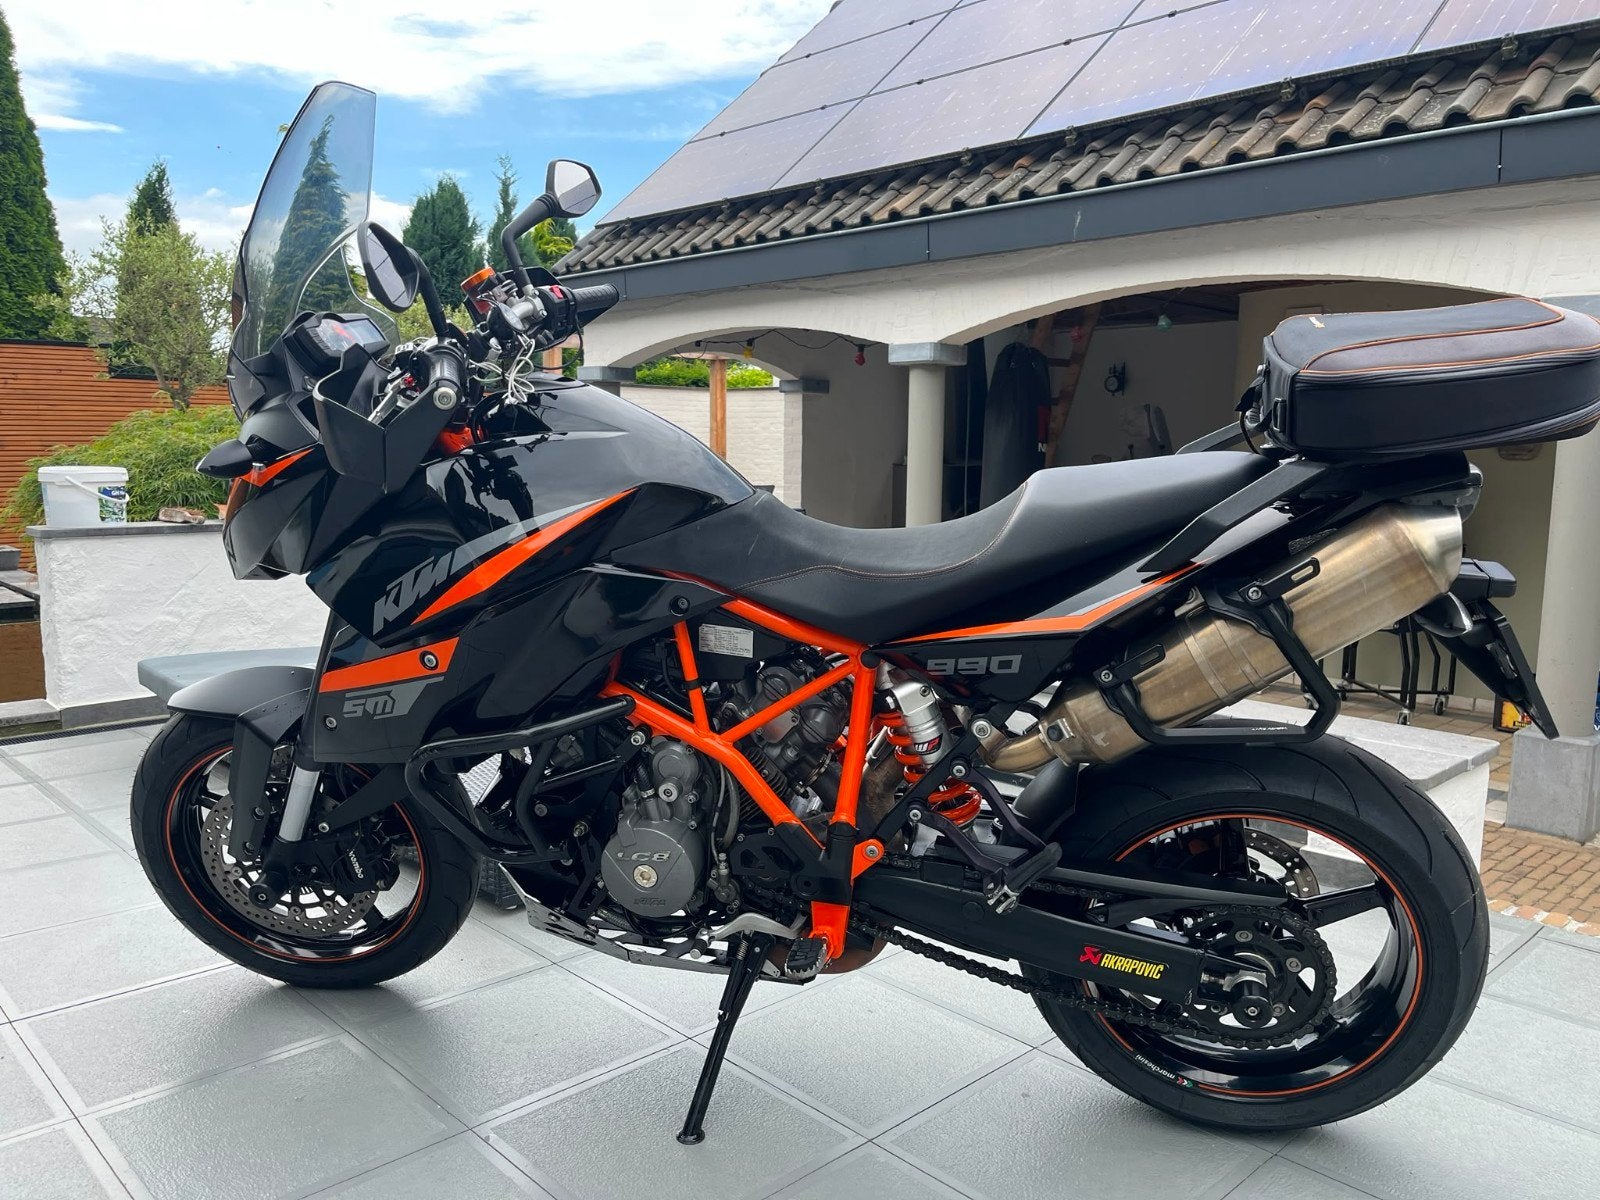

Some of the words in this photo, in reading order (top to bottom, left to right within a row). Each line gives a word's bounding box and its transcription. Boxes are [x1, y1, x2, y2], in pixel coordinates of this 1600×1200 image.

[373, 551, 453, 636] KTM
[926, 655, 1023, 676] 990
[914, 738, 940, 753] WP
[1134, 1054, 1176, 1080] marchesini
